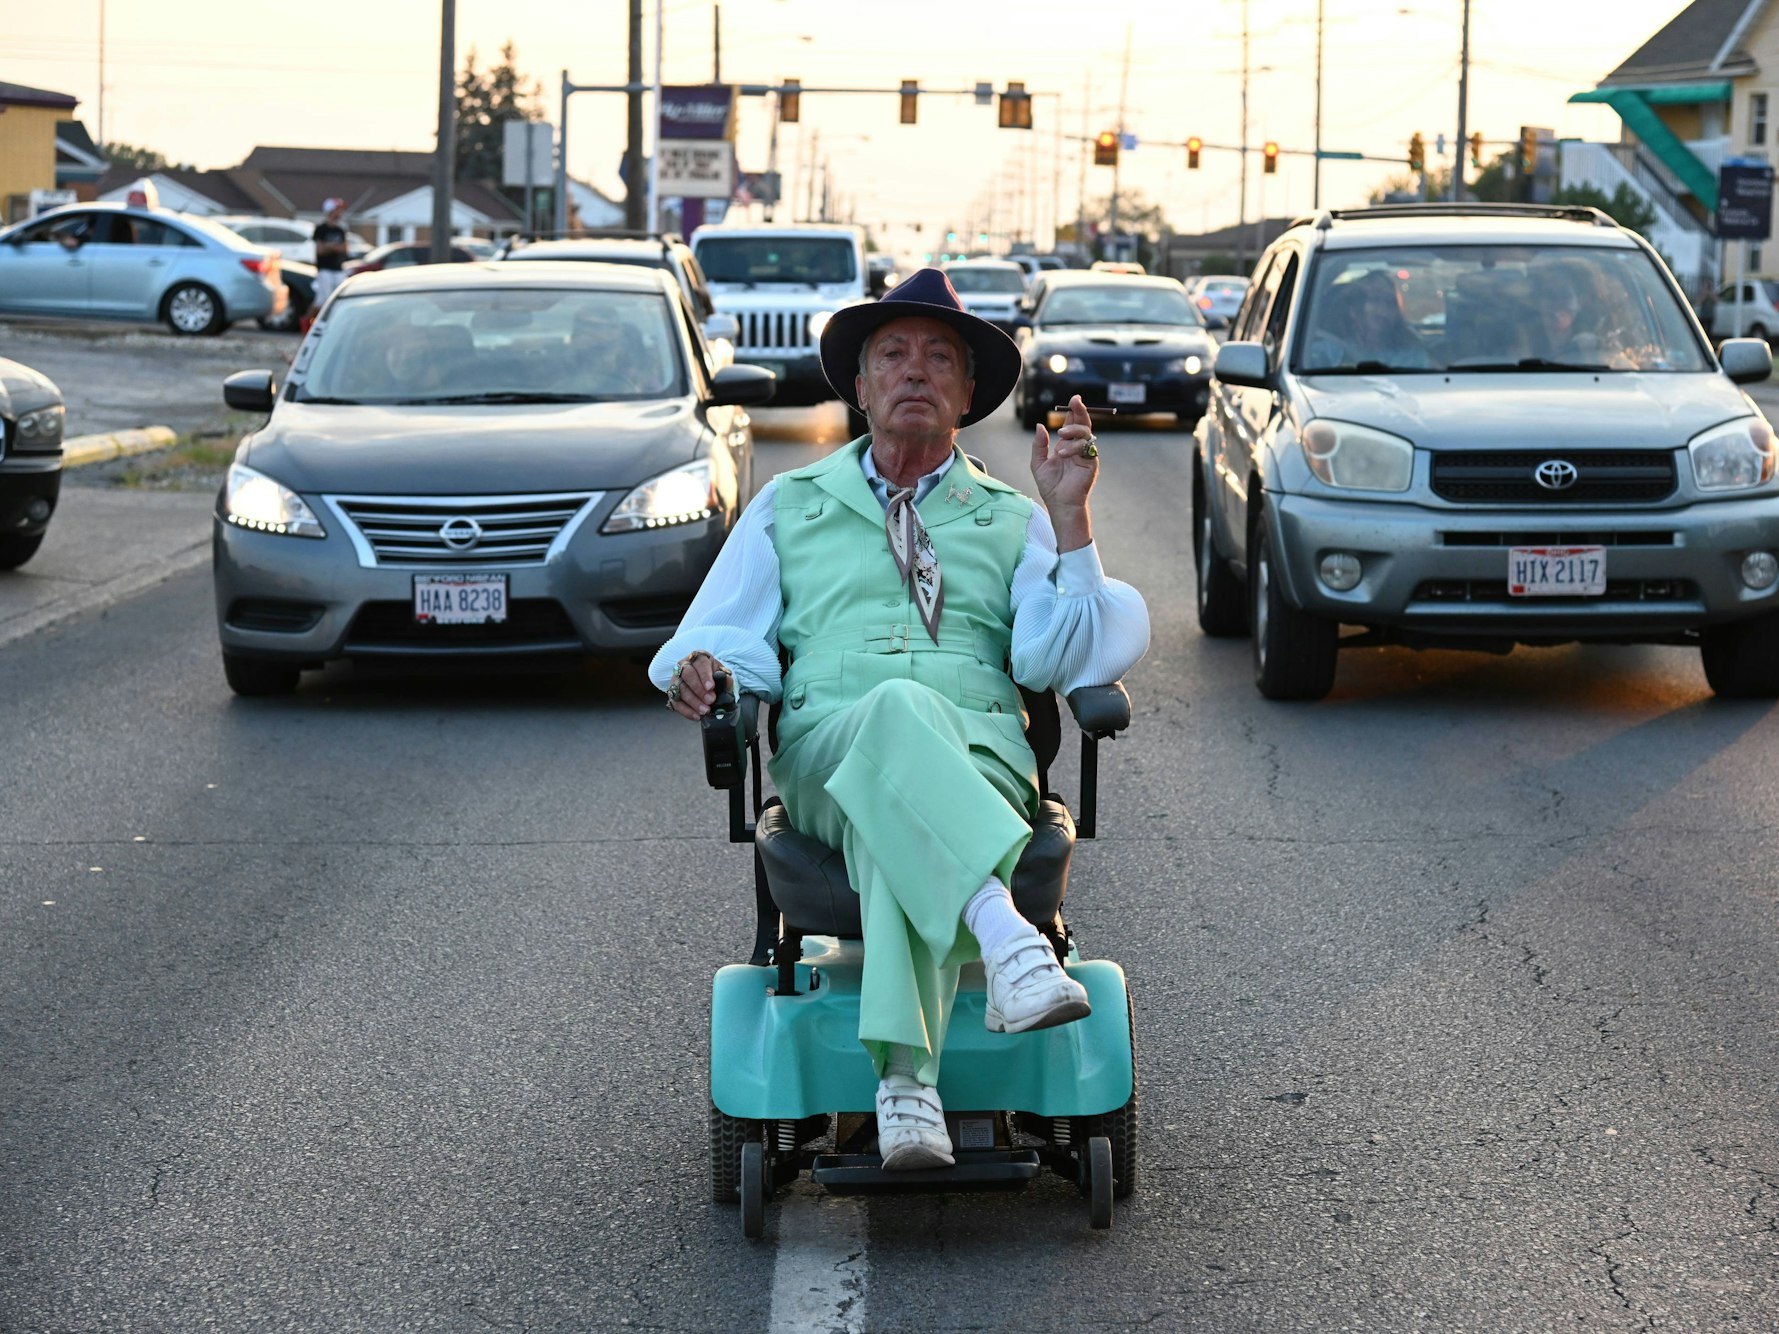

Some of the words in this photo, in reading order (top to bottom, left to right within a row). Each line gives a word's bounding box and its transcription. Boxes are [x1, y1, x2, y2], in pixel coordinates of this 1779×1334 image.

[1516, 559, 1549, 584] HIX
[1555, 559, 1599, 583] 2117
[420, 589, 453, 612] HAA
[459, 588, 502, 612] 8238
